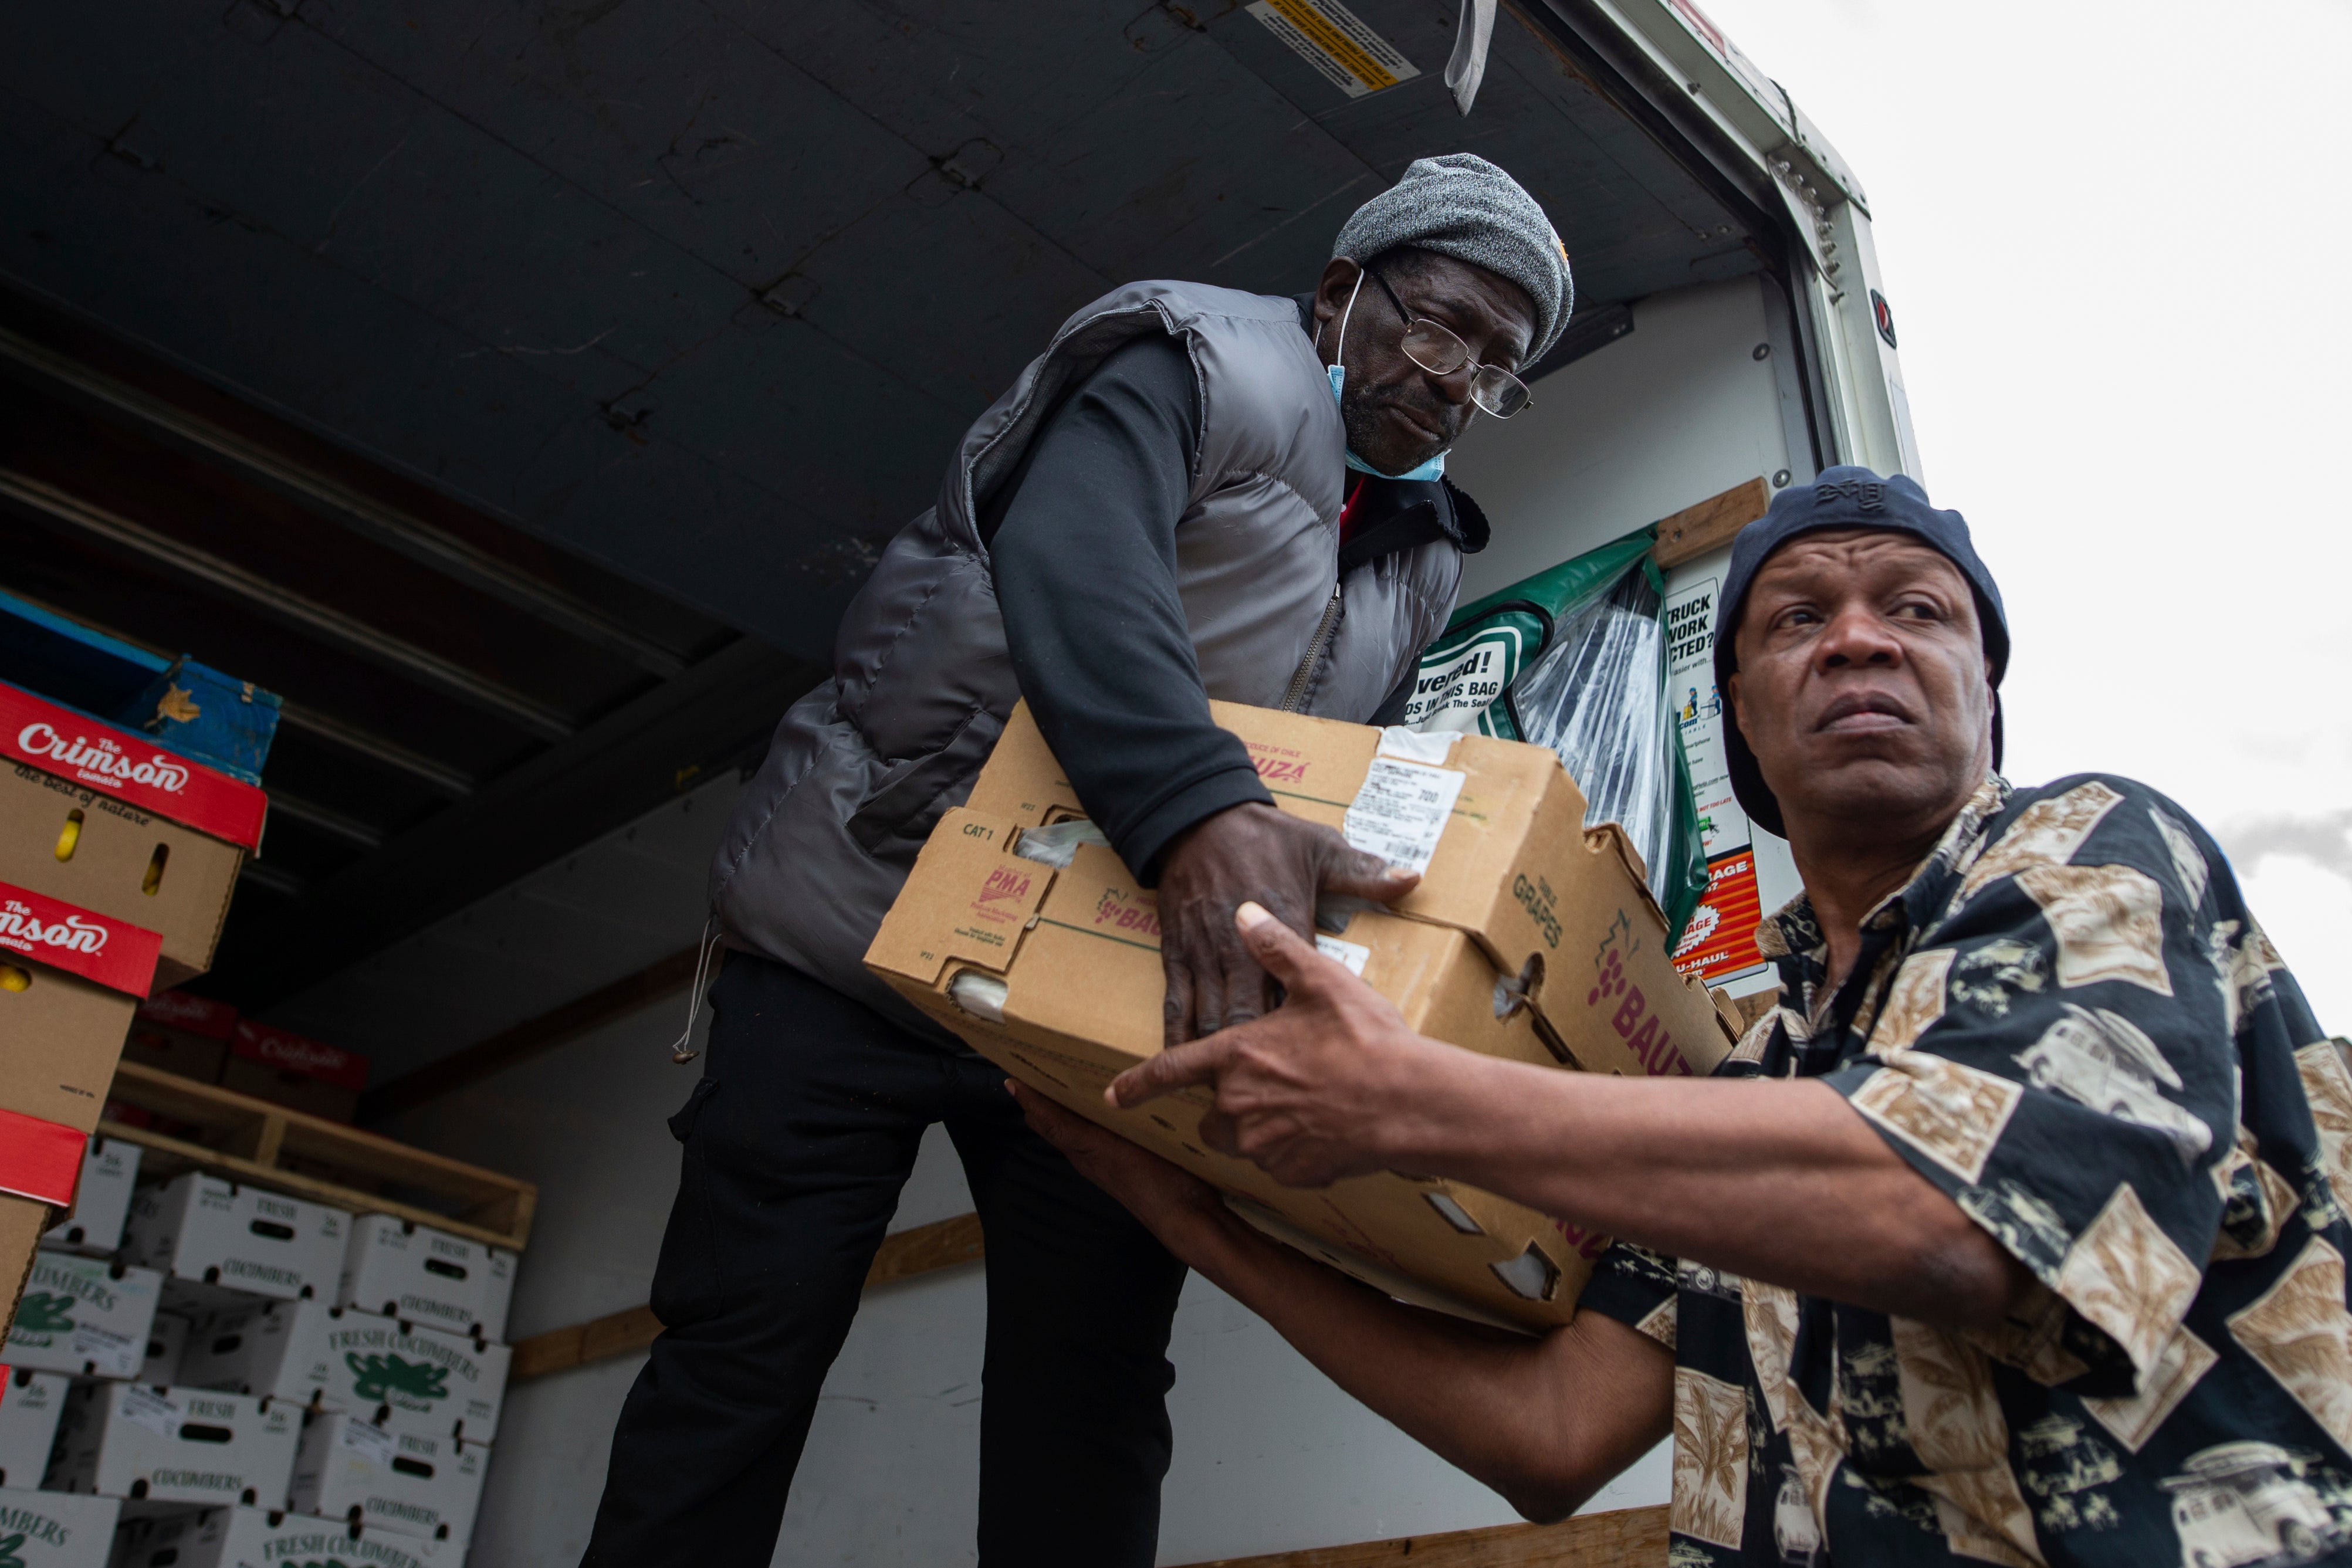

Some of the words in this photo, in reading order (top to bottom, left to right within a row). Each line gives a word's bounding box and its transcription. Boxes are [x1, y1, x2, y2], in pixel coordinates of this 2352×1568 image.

[1426, 698, 1439, 712] IN
[1440, 683, 1464, 703] THIS
[1468, 682, 1498, 696] BAG
[1453, 699, 1468, 708] The
[18, 722, 189, 793] Crimson
[98, 737, 122, 754] The
[76, 768, 123, 788] tomato
[1249, 755, 1312, 784] UZA
[14, 764, 41, 783] the
[43, 775, 77, 798] best
[79, 792, 96, 808] of
[97, 800, 151, 827] nature
[963, 823, 986, 838] CAT
[987, 829, 994, 841] 1
[984, 868, 1031, 896] PMA
[5, 900, 32, 916] The
[1512, 873, 1564, 949] GRAPES
[1683, 916, 1711, 936] AGE
[256, 1197, 297, 1220] FRESH
[222, 1258, 303, 1286] CUCUMBERS
[400, 1293, 473, 1324] CUCUMBERS
[329, 1327, 386, 1352] FRESH
[386, 1329, 479, 1383] CUCUMBERS
[188, 1398, 236, 1419] FRESH
[398, 1432, 438, 1457] FRESH
[151, 1468, 244, 1492] CUCUMBERS
[364, 1496, 440, 1526] CUCUMBERS
[263, 1533, 326, 1562] FRESH
